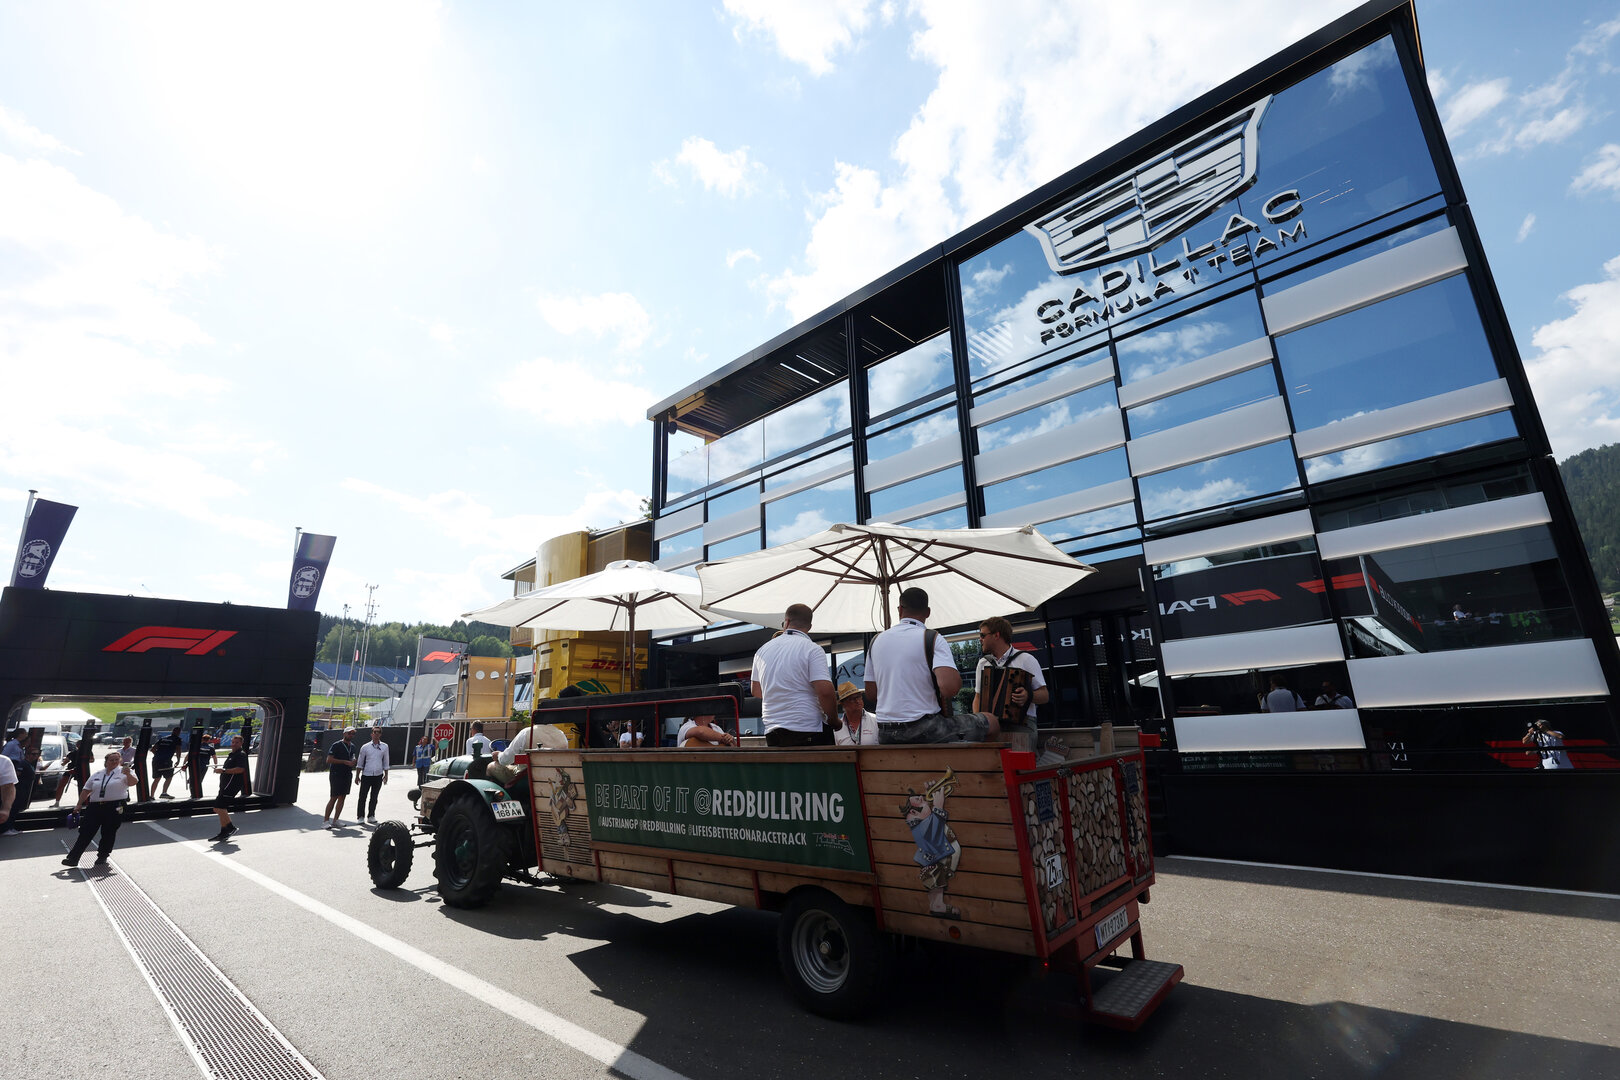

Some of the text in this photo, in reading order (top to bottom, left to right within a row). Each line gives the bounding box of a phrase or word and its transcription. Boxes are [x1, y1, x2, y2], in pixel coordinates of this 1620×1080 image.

[1035, 189, 1304, 325] CADILLAC
[1040, 280, 1175, 346] FORMULA
[1207, 220, 1308, 274] TEAM
[101, 625, 239, 656] F1
[435, 728, 453, 738] STOP
[500, 802, 511, 810] MT
[594, 783, 845, 823] BE PART OF IT @REDBULLRING
